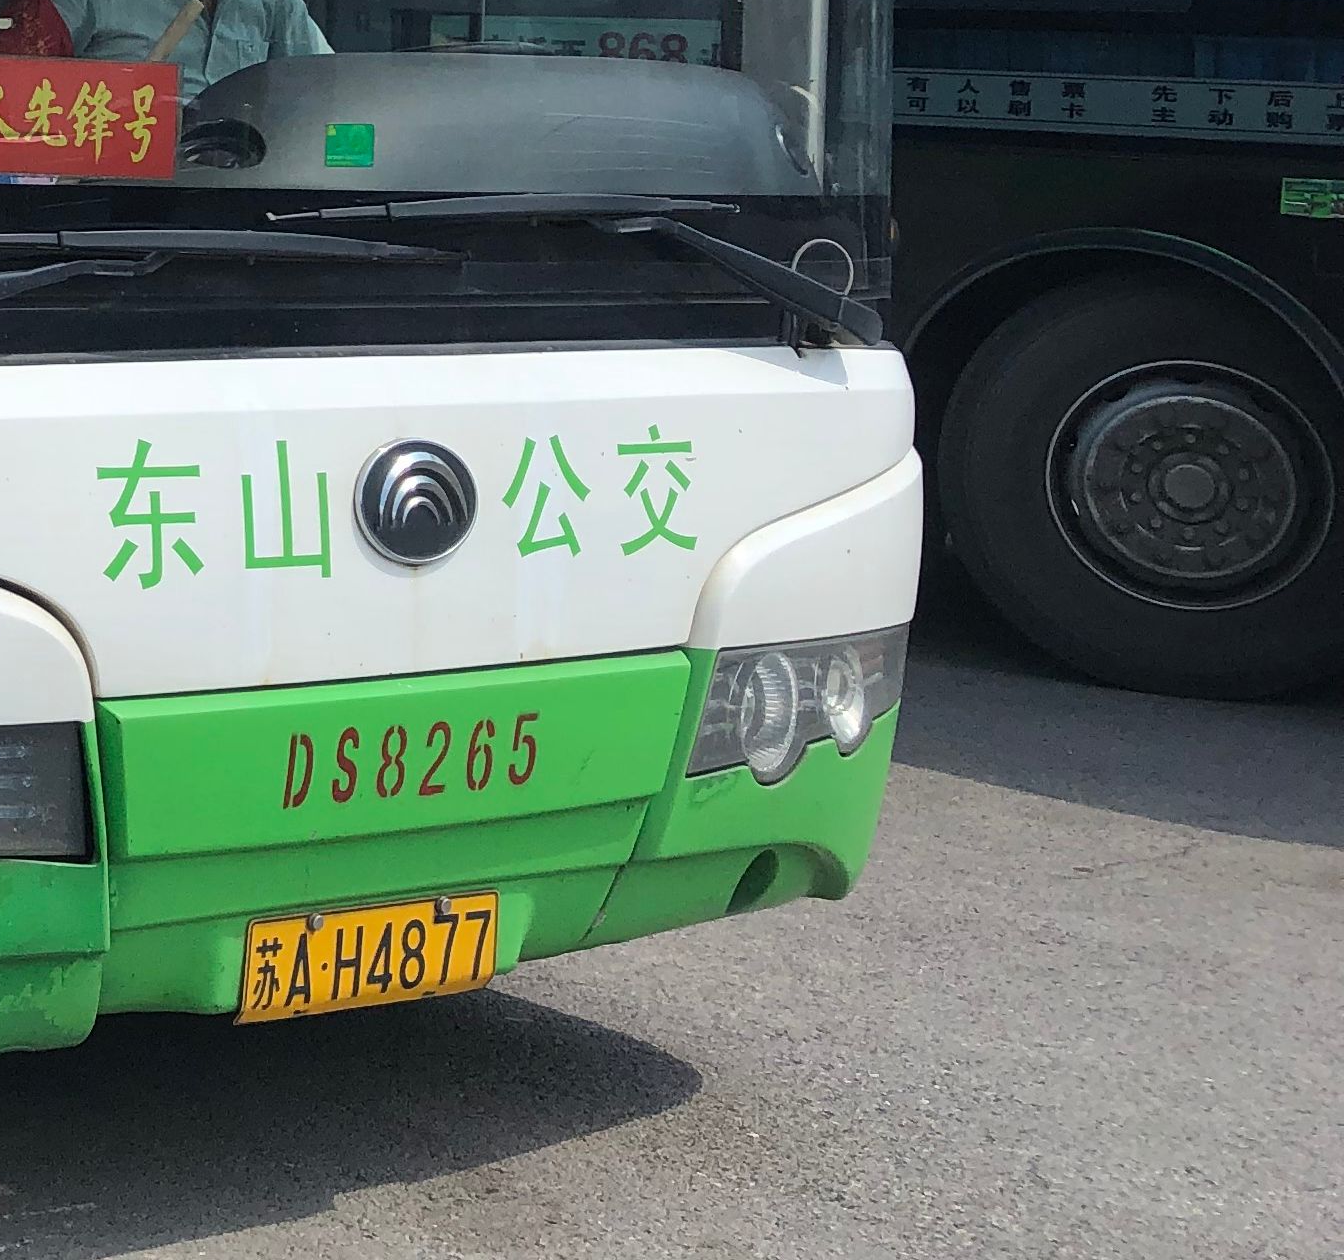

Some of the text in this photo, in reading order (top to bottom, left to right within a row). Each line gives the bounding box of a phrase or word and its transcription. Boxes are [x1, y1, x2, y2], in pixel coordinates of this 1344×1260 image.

[598, 30, 689, 64] 868
[905, 76, 1087, 99] 有人售票
[905, 96, 1087, 120] 可以刷卡
[97, 423, 698, 590] 东山 公交
[282, 710, 540, 810] DS8265
